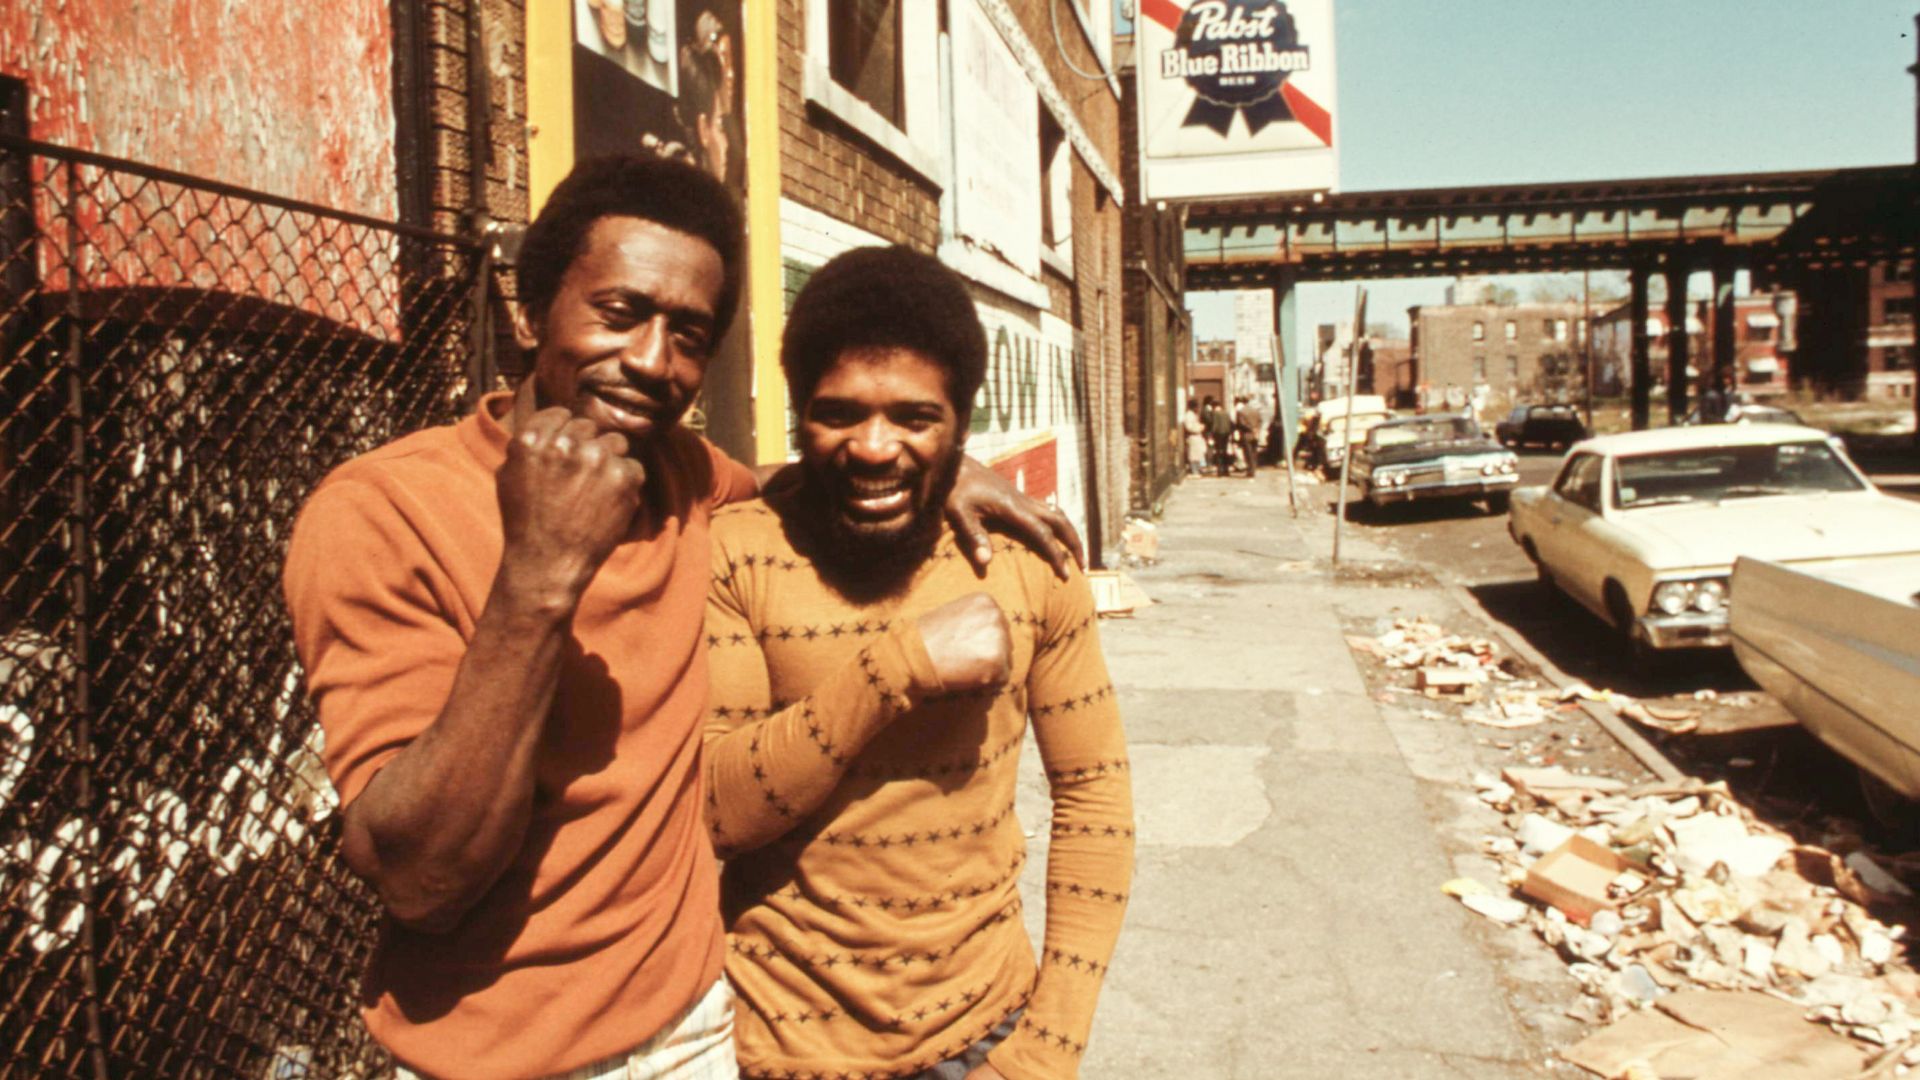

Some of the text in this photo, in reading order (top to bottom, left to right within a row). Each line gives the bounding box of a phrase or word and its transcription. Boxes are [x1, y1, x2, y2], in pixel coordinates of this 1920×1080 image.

[1190, 1, 1278, 41] Pabst
[1163, 42, 1309, 78] Blue Ribbon
